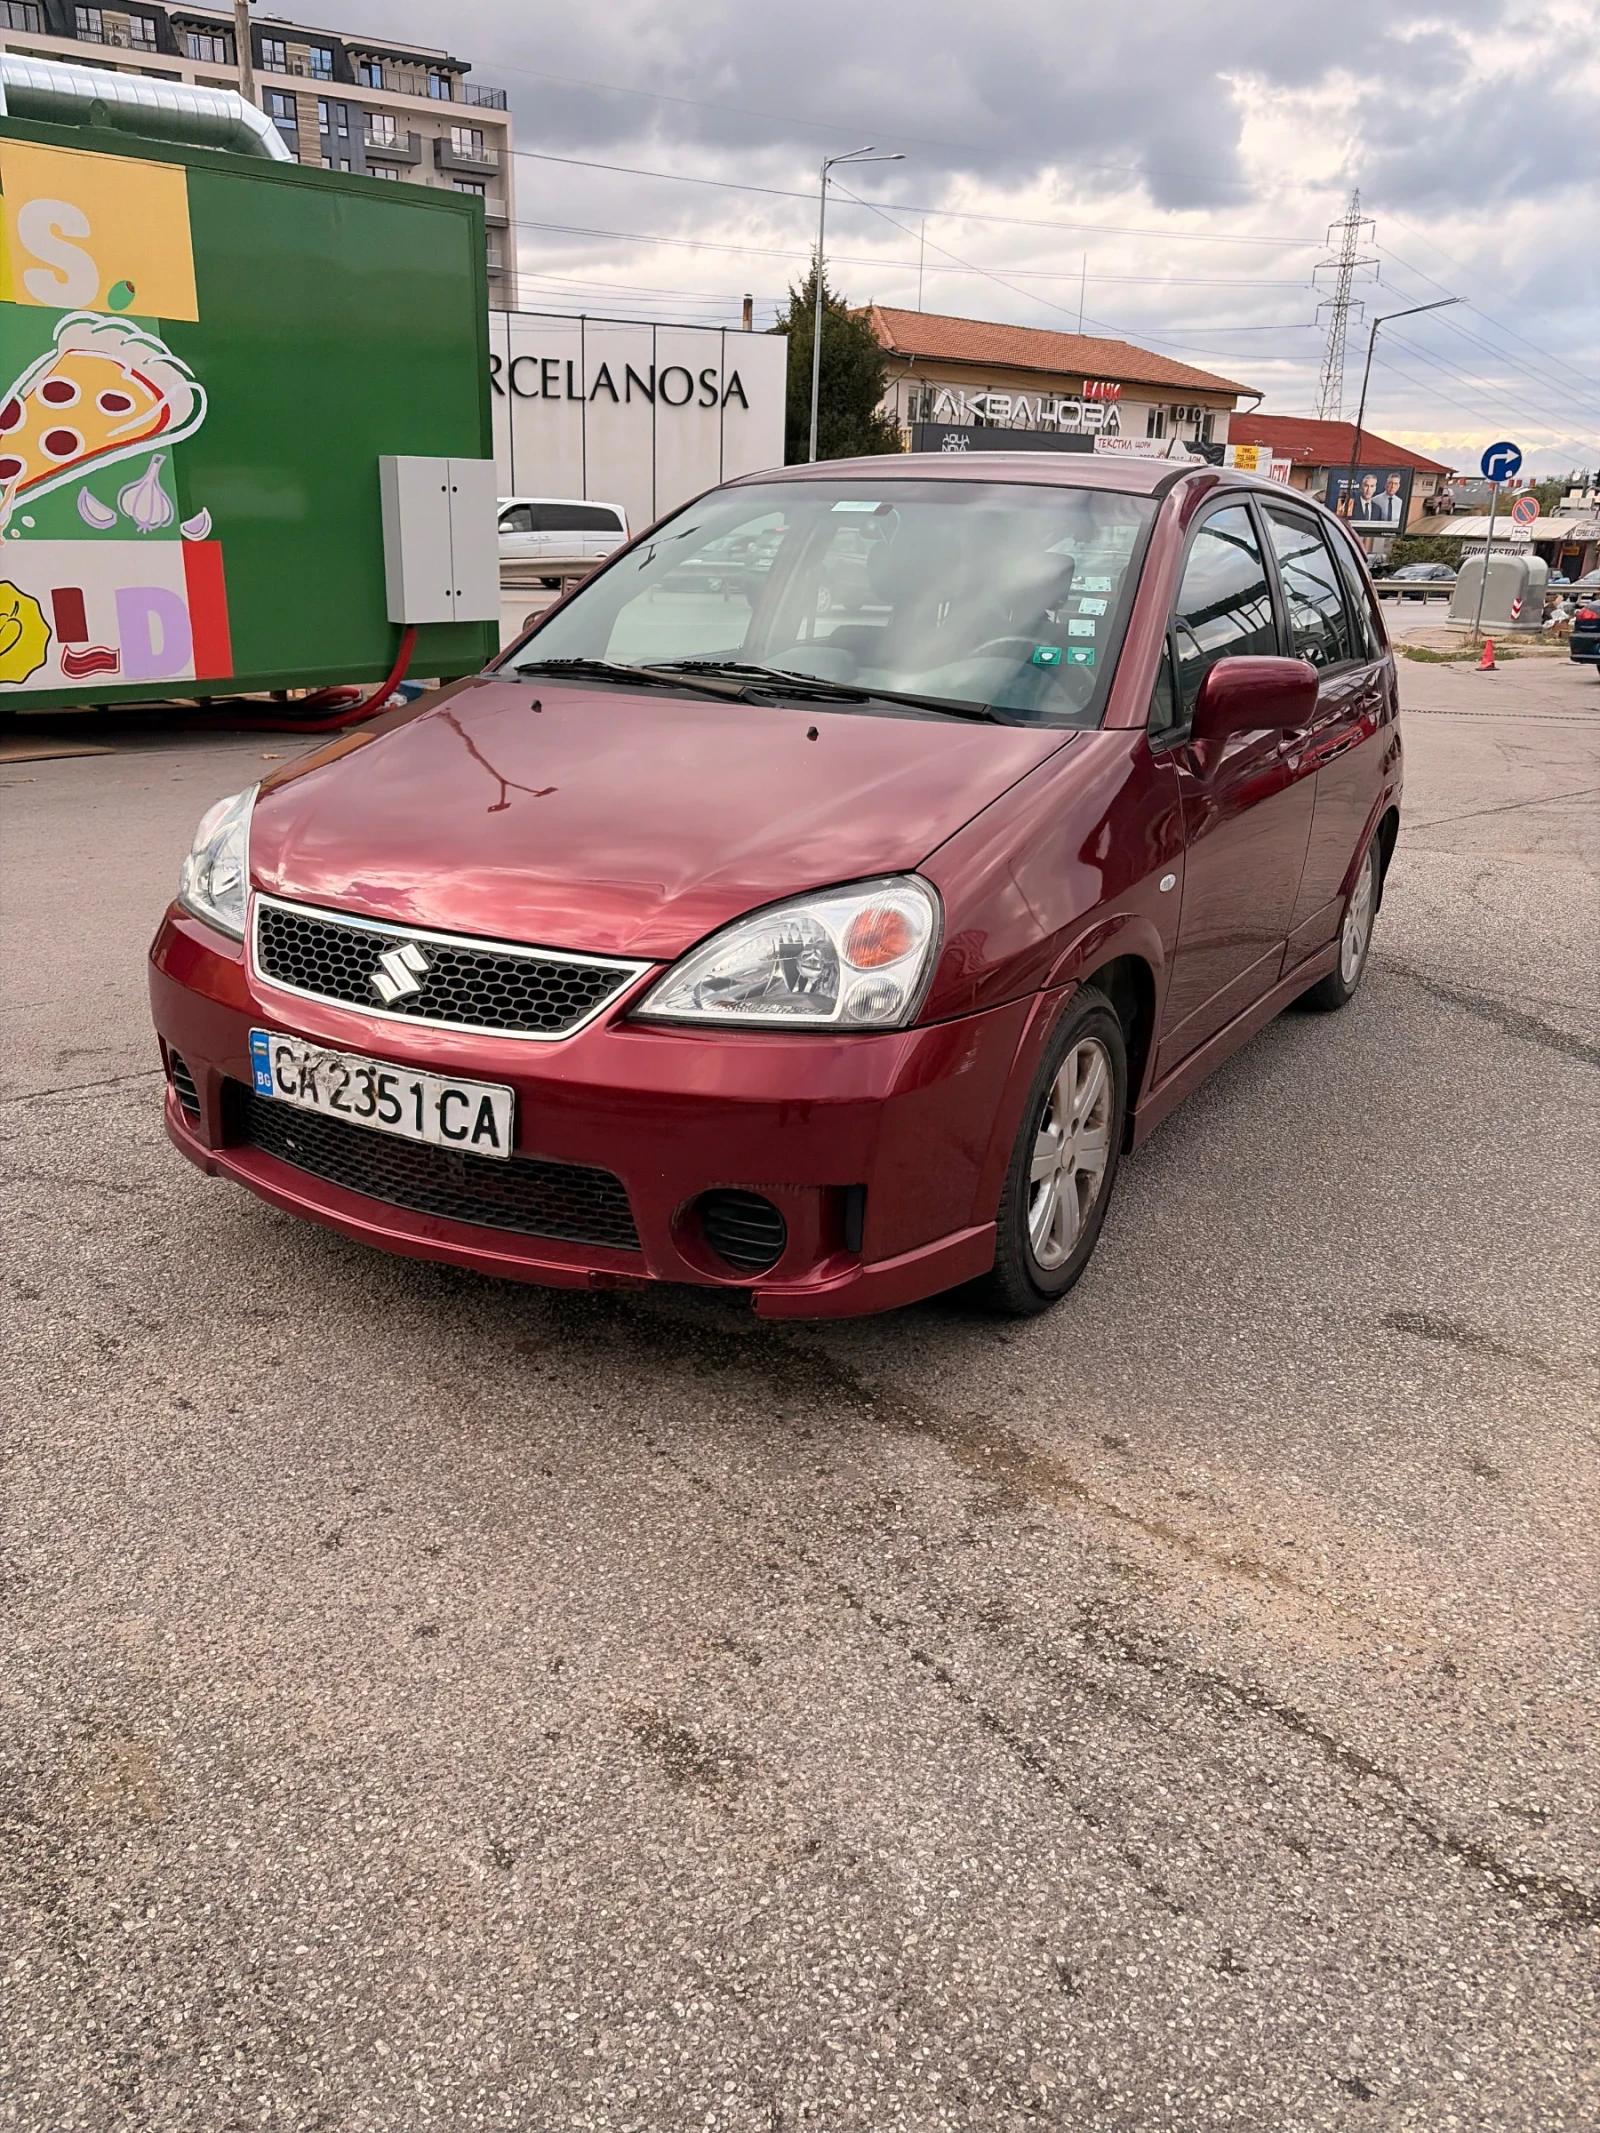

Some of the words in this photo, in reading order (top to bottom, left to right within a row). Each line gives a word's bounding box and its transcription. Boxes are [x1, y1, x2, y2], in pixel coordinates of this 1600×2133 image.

[1082, 380, 1122, 401] БАНИ
[932, 388, 1122, 430] АКВАНОВА
[942, 433, 970, 445] AQUA
[1098, 438, 1132, 450] ТЕКСТИЛ
[257, 1070, 272, 1088] BG
